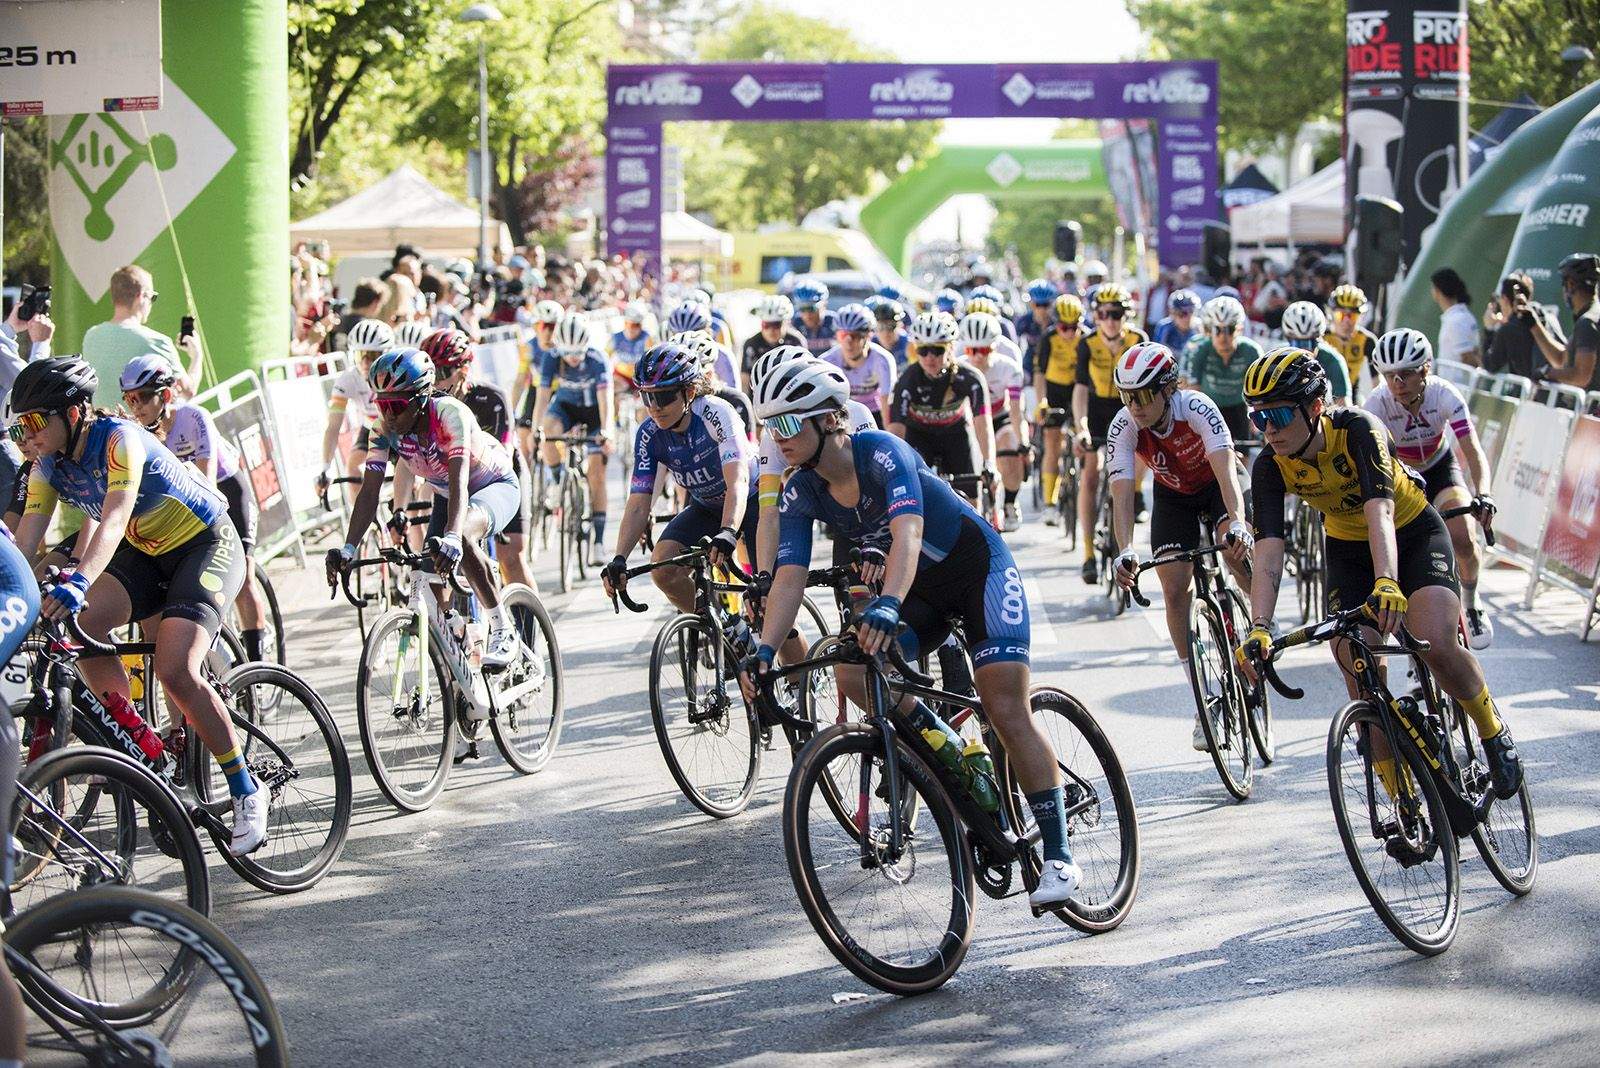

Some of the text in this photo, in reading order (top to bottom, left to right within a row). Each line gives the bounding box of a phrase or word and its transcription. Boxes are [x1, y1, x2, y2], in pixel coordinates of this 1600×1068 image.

[1347, 18, 1388, 45] RO
[0, 46, 76, 66] 25 m
[1348, 43, 1402, 72] IDE
[1414, 44, 1469, 72] RID
[1189, 398, 1224, 435] Cofidis
[638, 430, 651, 470] Roand
[672, 467, 715, 487] RAEL
[206, 524, 235, 574] VIPEO
[0, 596, 28, 641] op
